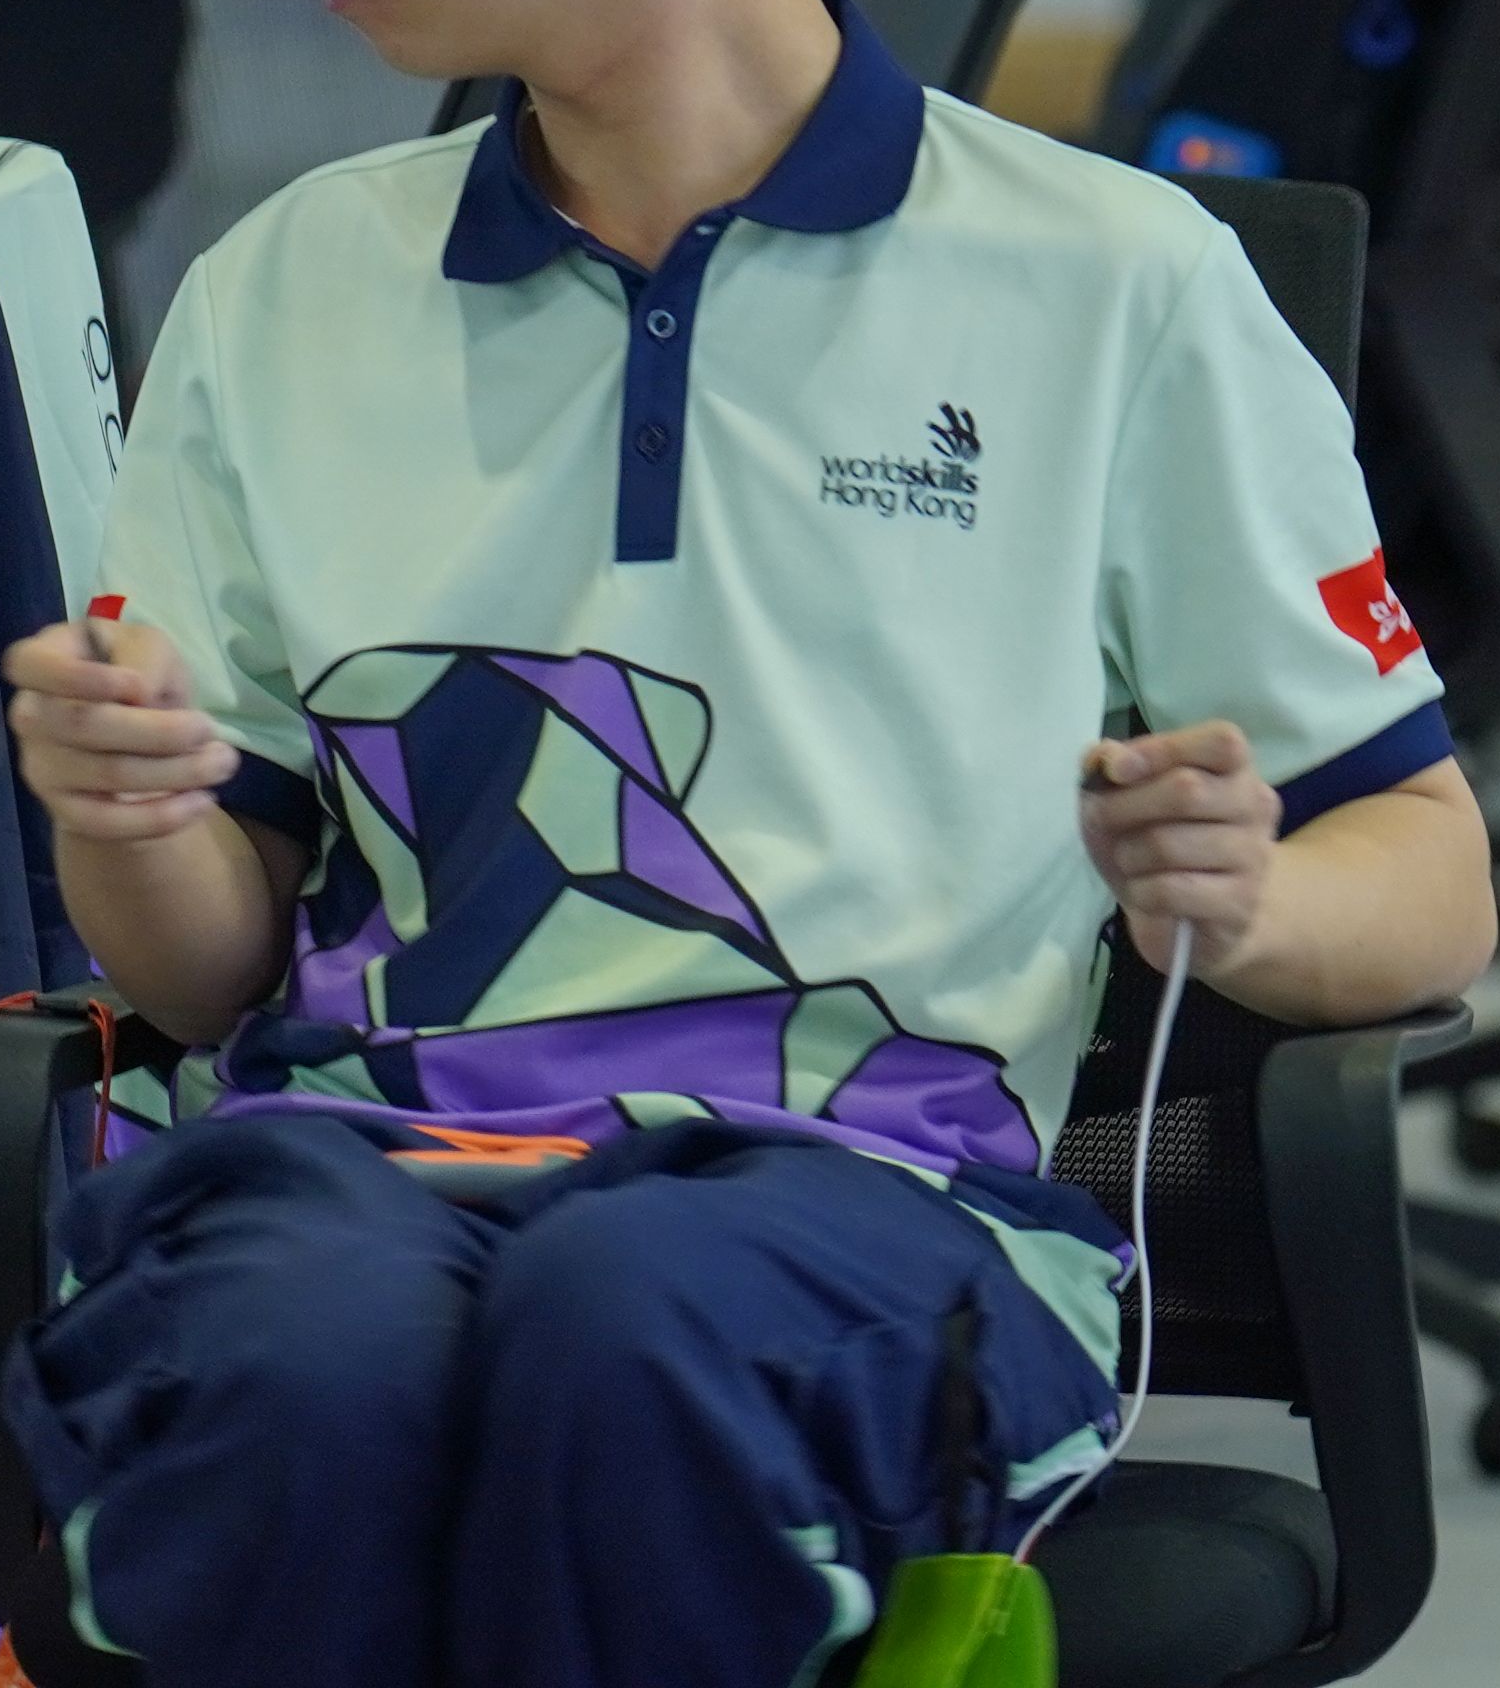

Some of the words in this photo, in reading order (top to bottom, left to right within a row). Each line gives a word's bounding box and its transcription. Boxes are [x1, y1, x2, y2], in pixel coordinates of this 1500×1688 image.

[819, 453, 979, 496] worldskills
[819, 476, 897, 518] Hong
[905, 485, 977, 530] Kong
